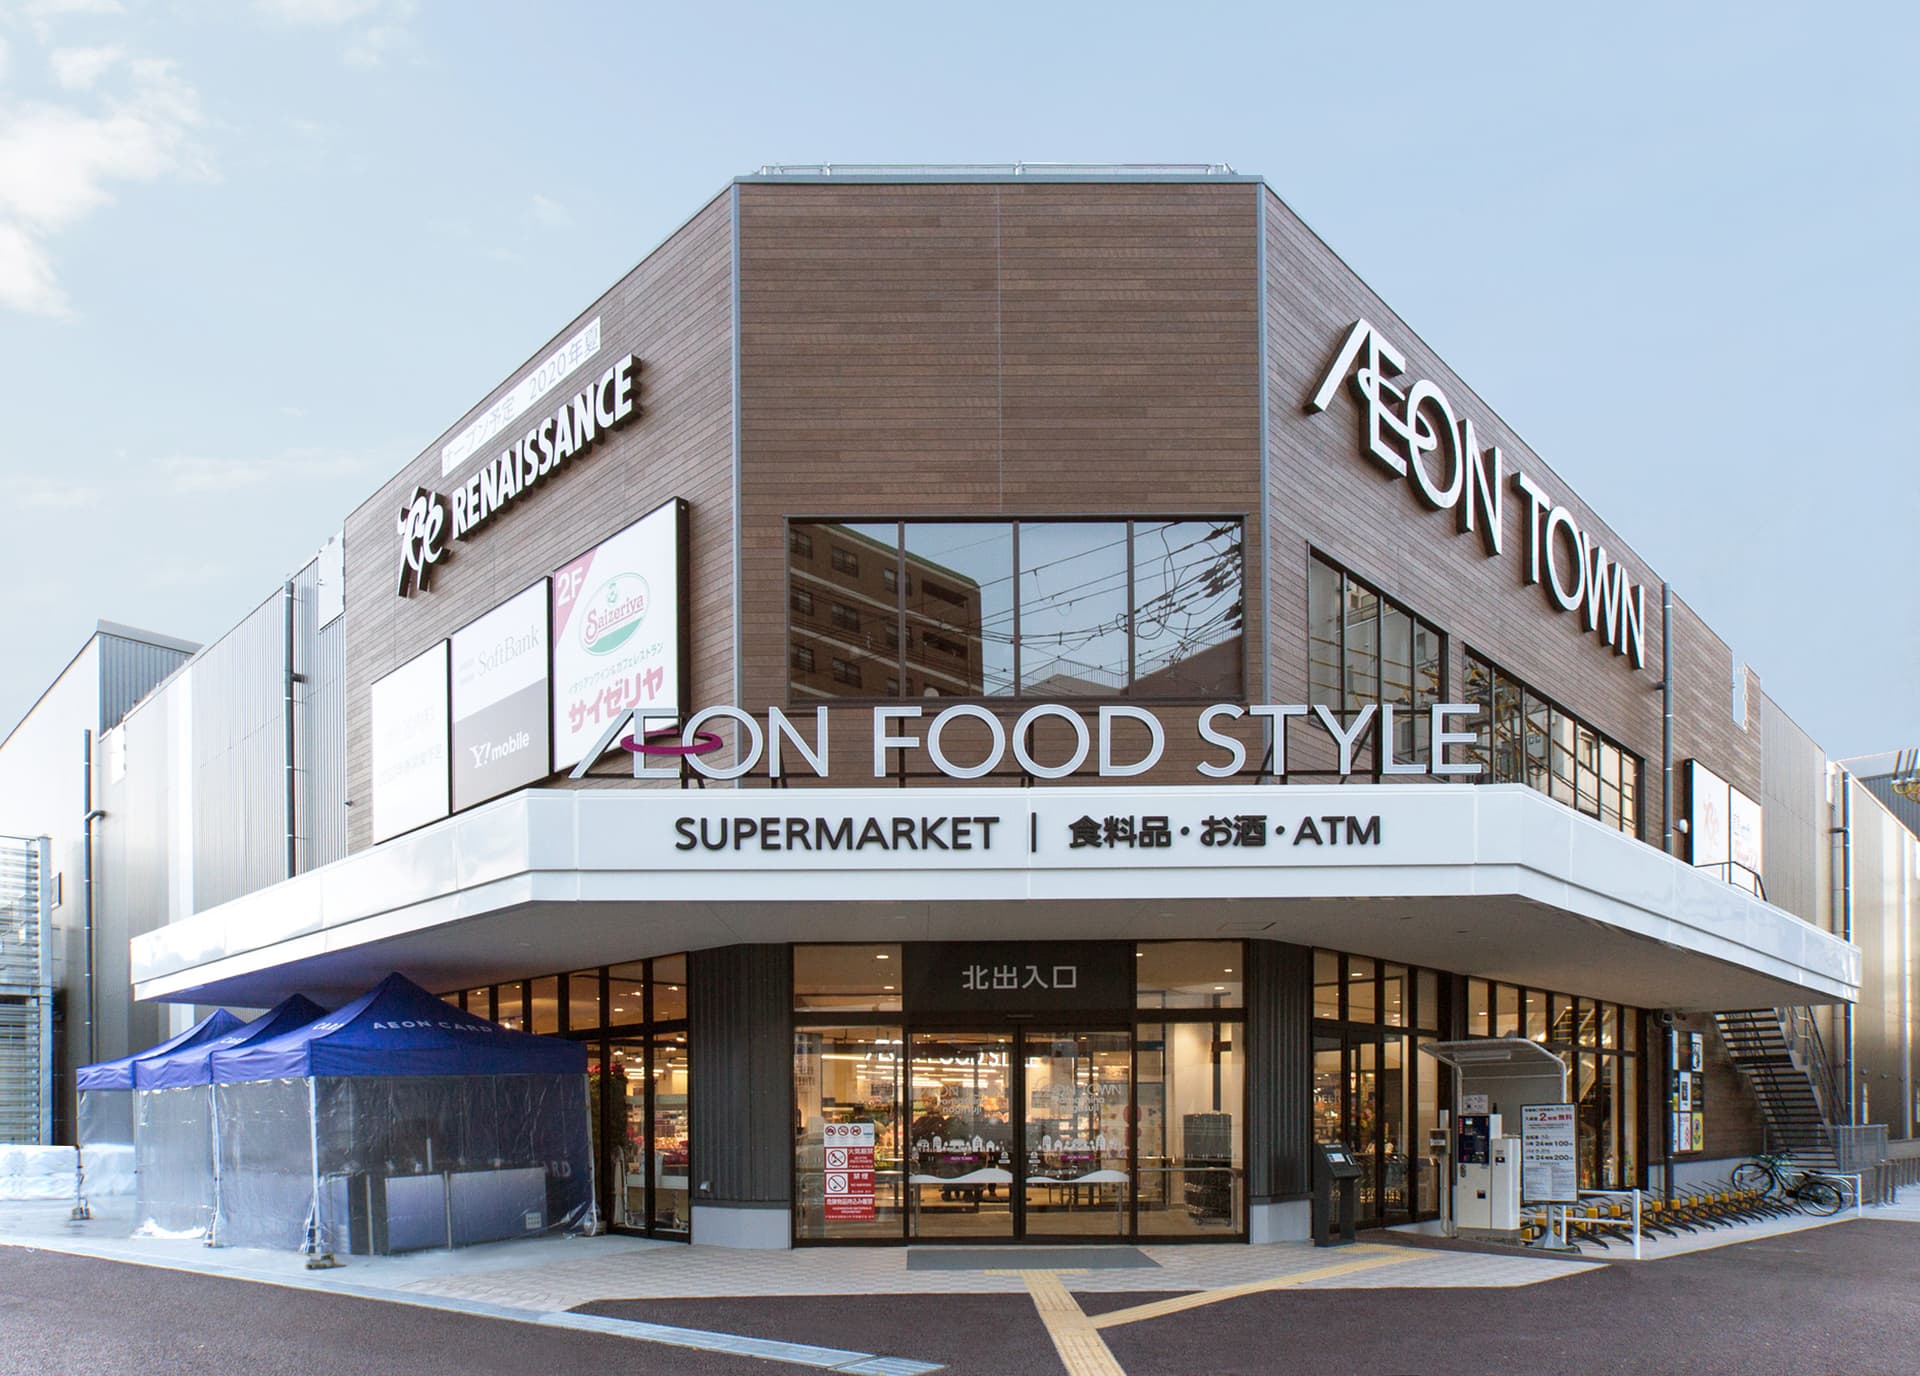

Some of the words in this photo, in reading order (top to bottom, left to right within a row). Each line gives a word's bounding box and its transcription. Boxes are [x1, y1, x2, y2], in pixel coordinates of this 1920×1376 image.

[451, 353, 635, 540] RENAISSANCE
[557, 566, 583, 607] 2F
[1517, 471, 1645, 670] TOWN
[584, 595, 645, 645] Saizeriya
[478, 624, 541, 676] SoftBank
[568, 665, 664, 733] サイゼリヤ
[873, 704, 1165, 779] FOOD
[1197, 703, 1483, 777] STYLE
[674, 816, 1001, 851] SUPERMARKET
[962, 964, 1077, 991] 北出入口
[373, 1019, 432, 1030] AEON
[438, 1020, 493, 1033] CARD
